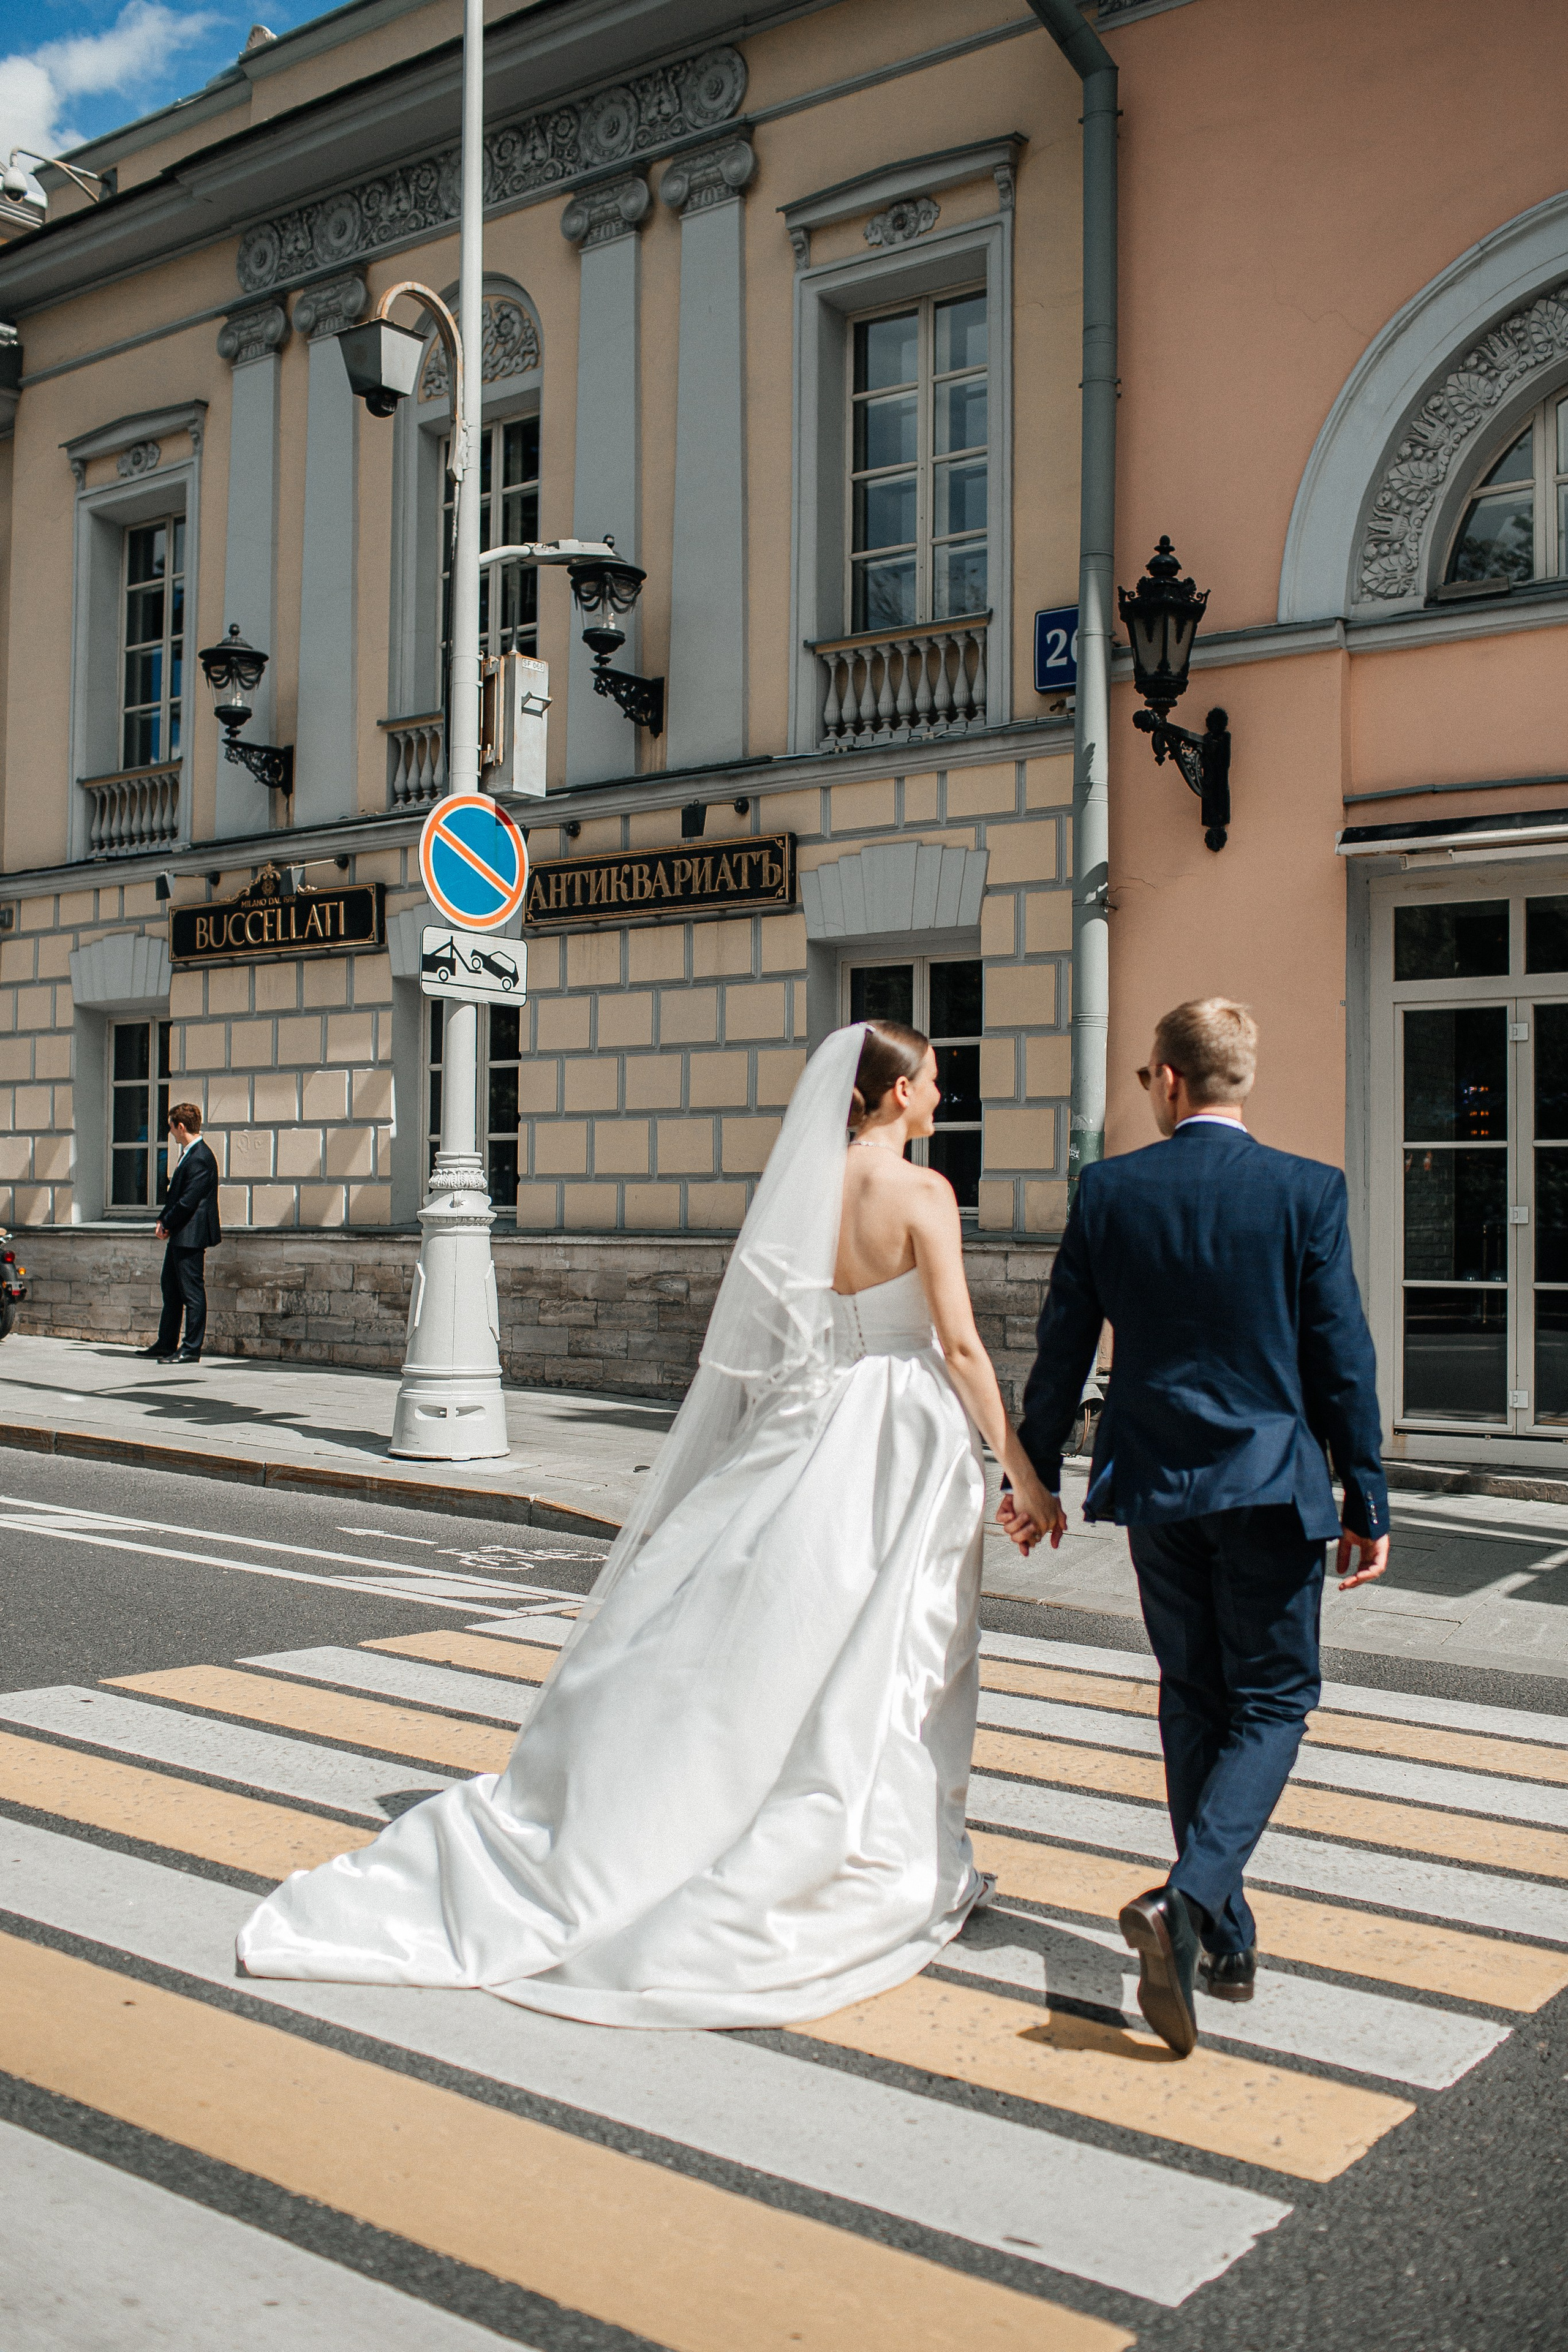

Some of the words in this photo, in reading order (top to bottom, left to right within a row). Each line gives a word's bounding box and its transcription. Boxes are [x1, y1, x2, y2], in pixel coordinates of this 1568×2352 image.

[241, 898, 266, 908] MILANO
[268, 897, 281, 905] DAL
[528, 850, 782, 911] АНТИКВАРИАТЪ
[196, 901, 345, 949] BUCCELLATI
